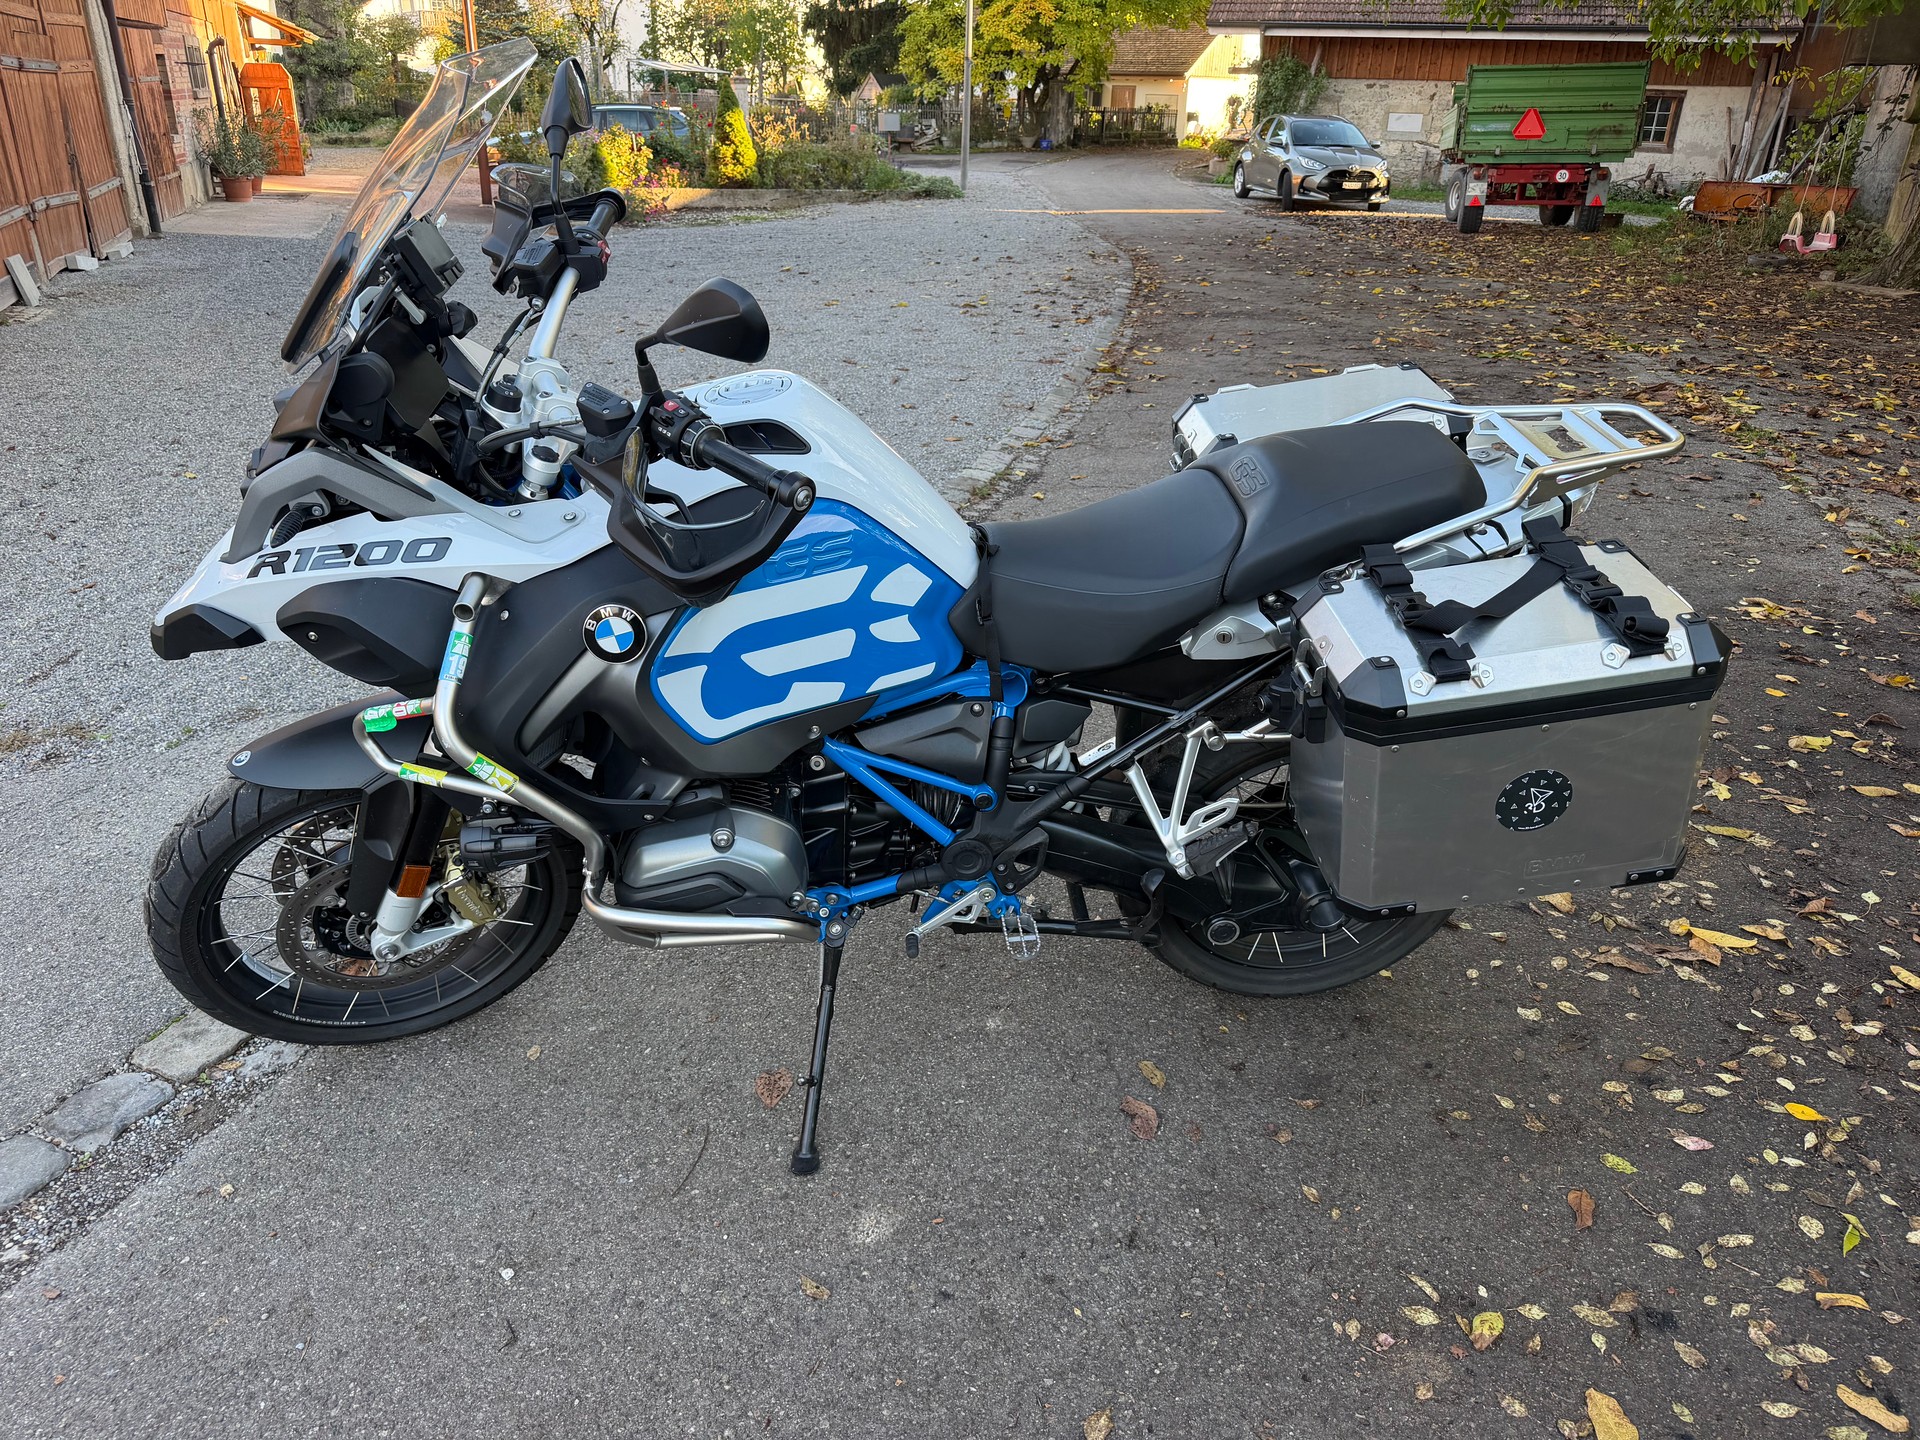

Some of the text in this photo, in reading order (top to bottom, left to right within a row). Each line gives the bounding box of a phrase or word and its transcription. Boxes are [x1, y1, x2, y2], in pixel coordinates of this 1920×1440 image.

[246, 537, 453, 579] R1200
[762, 533, 853, 584] GS
[585, 606, 636, 632] BMW
[1528, 853, 1586, 874] BMW
